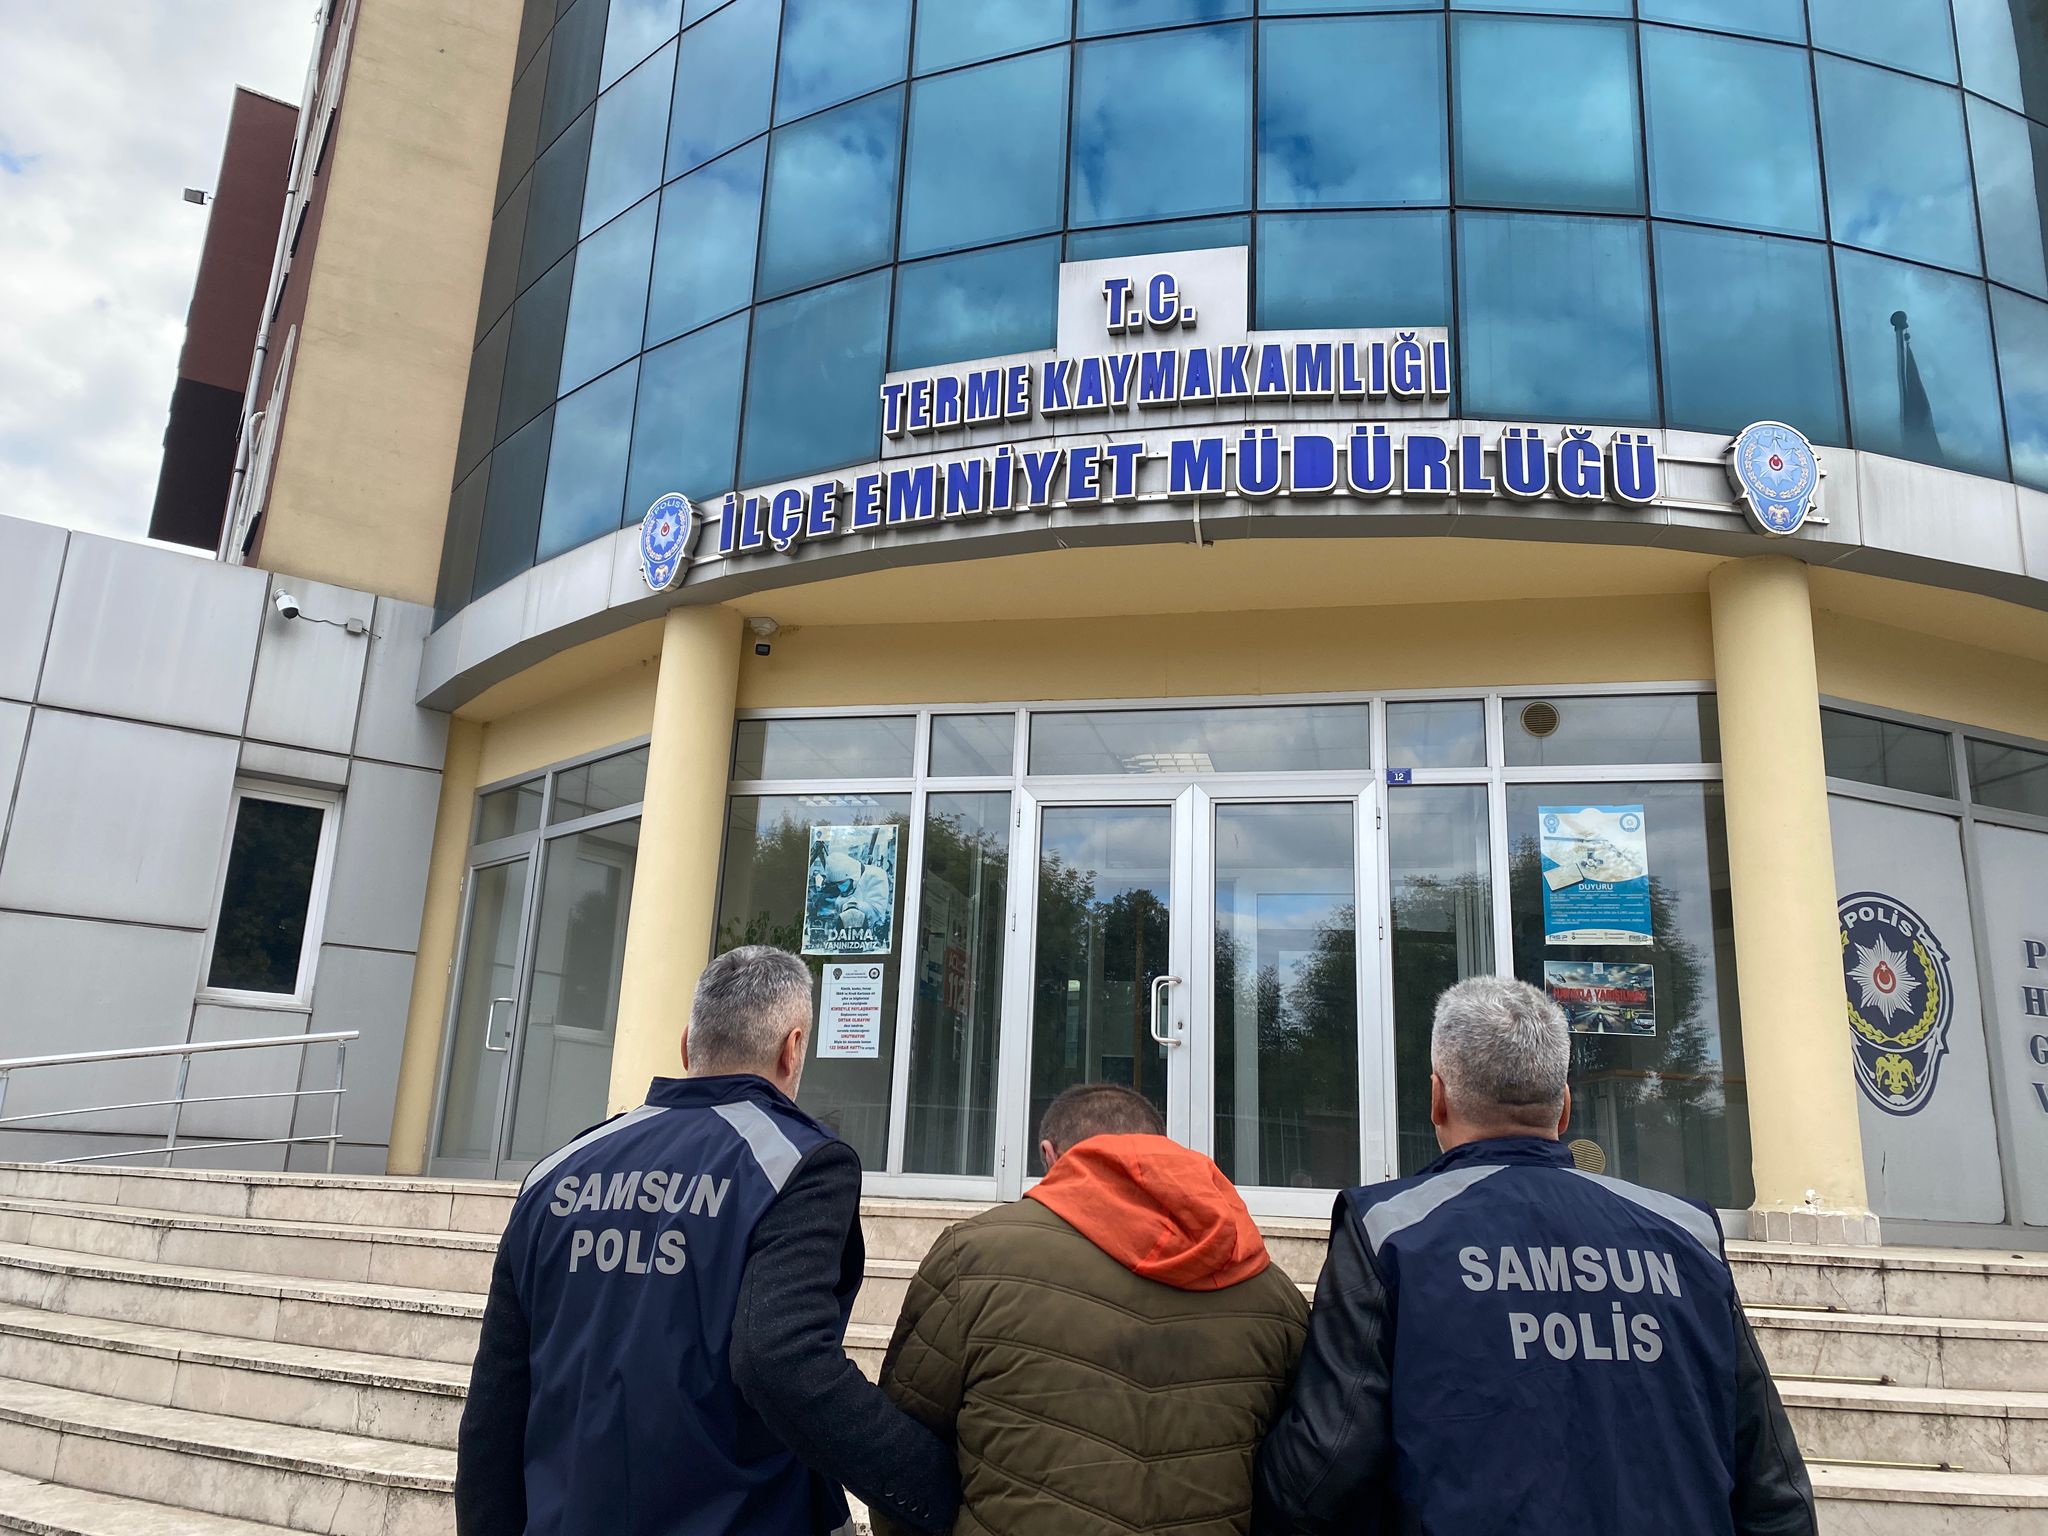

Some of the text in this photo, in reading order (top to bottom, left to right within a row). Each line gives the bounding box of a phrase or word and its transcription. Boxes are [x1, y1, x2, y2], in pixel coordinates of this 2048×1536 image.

[1102, 271, 1197, 334] T.C.
[880, 331, 1451, 439] TERME KAYMAKAMLIĞI
[719, 421, 1659, 553] İLÇE EMNİYET MÜDÜRLÜĞÜ
[1394, 772, 1404, 781] 12
[1578, 883, 1614, 891] DUYURU
[828, 926, 874, 941] DAİMA
[1843, 906, 1914, 937] POLİS
[550, 1170, 731, 1217] SAMSUN
[1458, 1246, 1682, 1297] SAMSUN
[1508, 1301, 1663, 1363] POLİS
